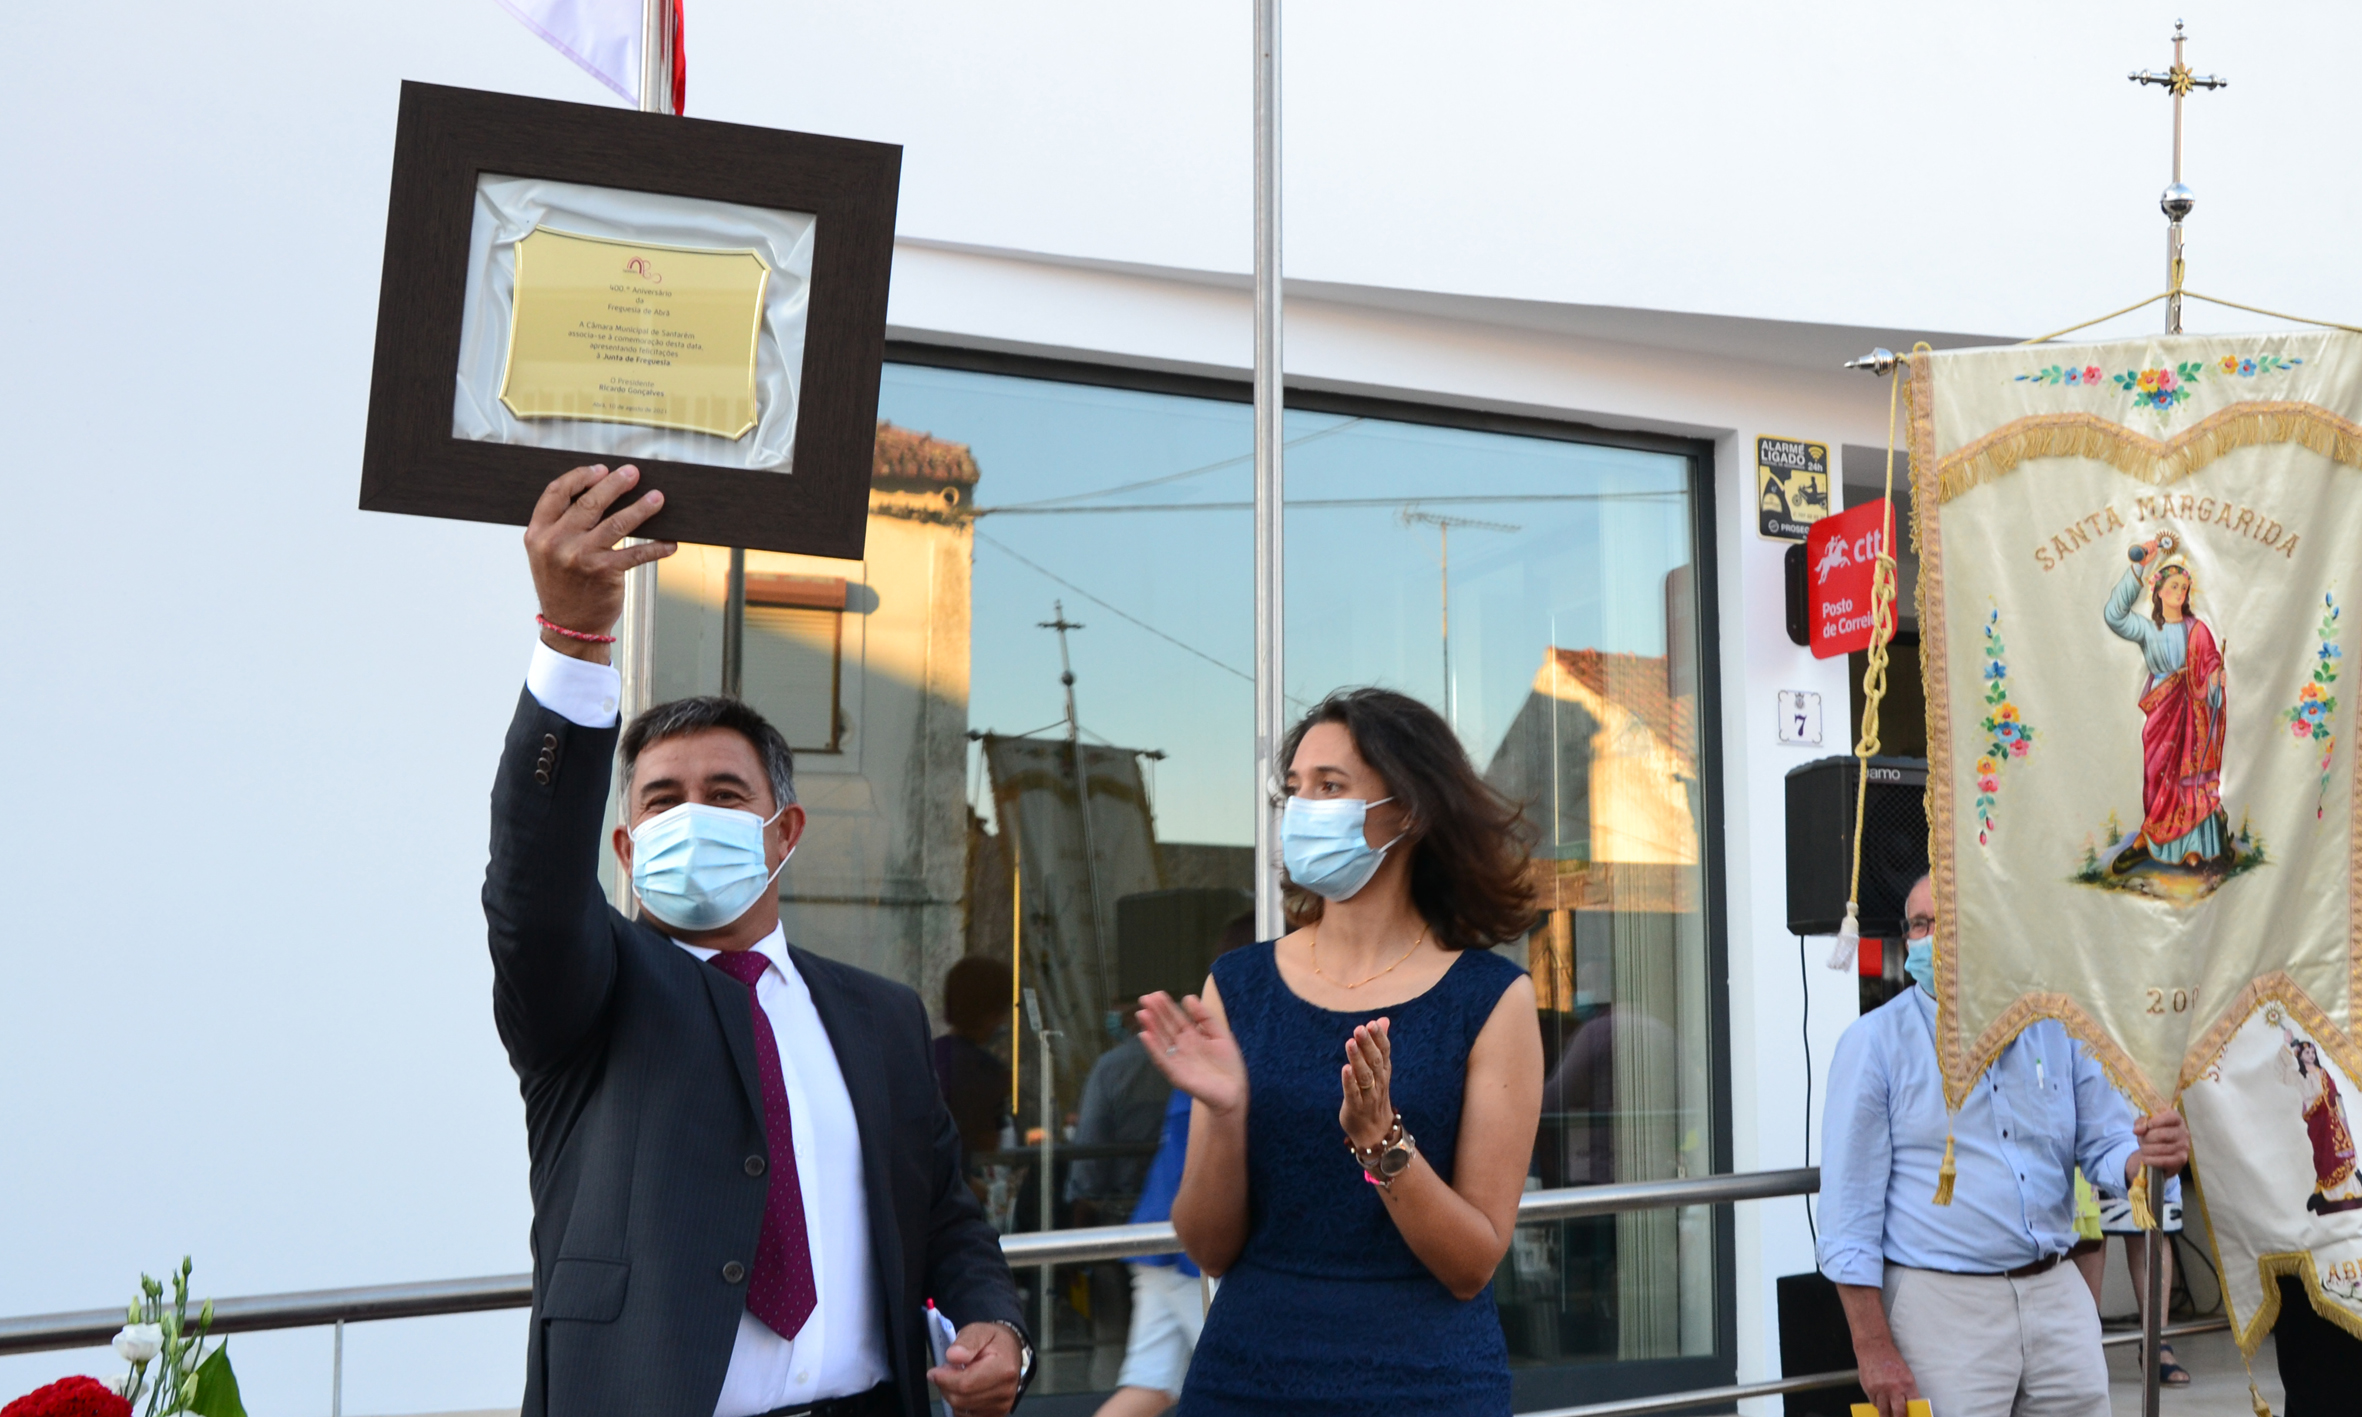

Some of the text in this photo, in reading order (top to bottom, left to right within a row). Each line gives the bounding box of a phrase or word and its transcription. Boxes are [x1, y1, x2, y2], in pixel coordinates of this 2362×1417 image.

[632, 286, 672, 298] Aniversário
[607, 304, 641, 314] Freguesia
[586, 321, 614, 331] Câmara
[615, 325, 648, 336] Municipal
[650, 328, 660, 336] de
[662, 329, 695, 340] Santarém
[568, 330, 606, 341] associa-se
[614, 335, 664, 347] comemoração
[666, 340, 684, 348] desta
[590, 342, 678, 359] apresentando felicitações
[603, 353, 623, 362] Junta
[636, 356, 671, 366] Freguesia
[599, 384, 664, 398] Ricardo Gonçalves
[618, 378, 654, 388] Presidente
[1761, 440, 1805, 455] ALARME
[1761, 450, 1806, 466] LIGADO
[1807, 462, 1823, 472] 24h
[2034, 493, 2302, 572] SANTA MARGARIDA
[1853, 528, 1882, 563] ctt
[1823, 598, 1853, 619] Posto
[1823, 611, 1876, 639] de Correi
[1794, 713, 1808, 737] 7
